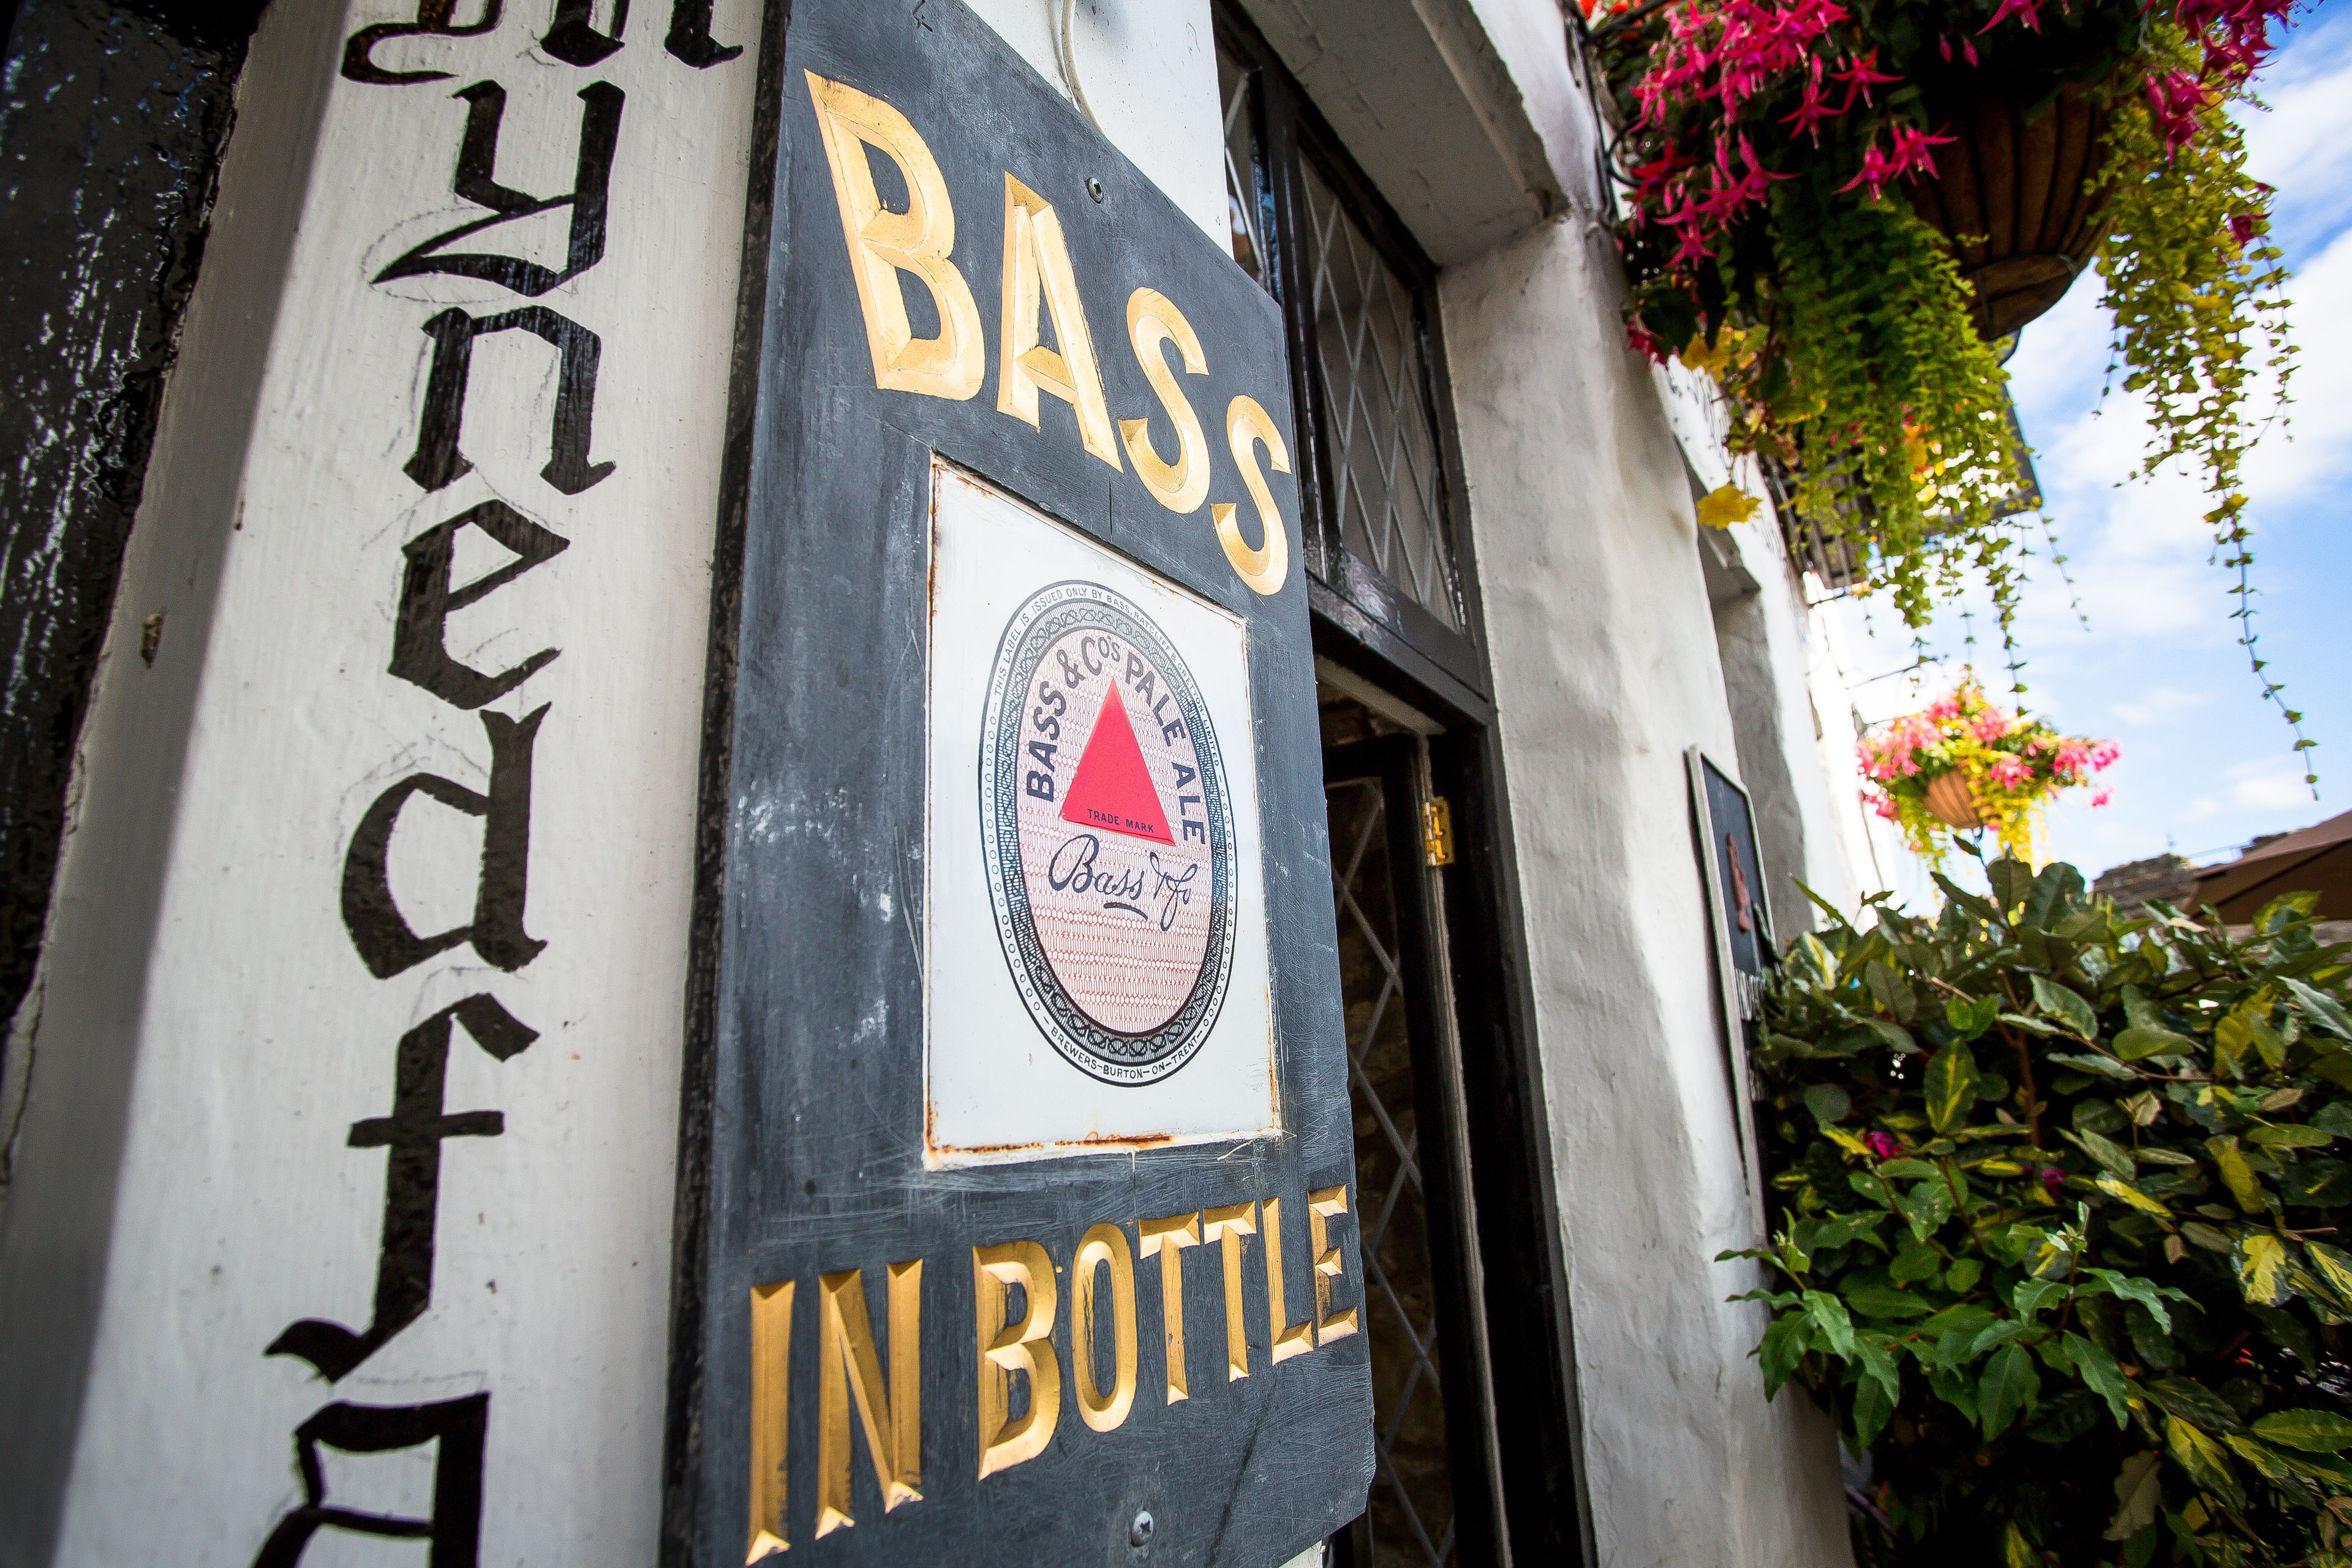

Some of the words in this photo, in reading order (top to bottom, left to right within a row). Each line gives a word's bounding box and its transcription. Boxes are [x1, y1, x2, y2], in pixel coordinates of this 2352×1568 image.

[804, 69, 1292, 595] BASS
[994, 666, 1007, 697] THIS
[1003, 628, 1022, 664] LABEL
[1020, 613, 1030, 626] IS
[1031, 589, 1063, 614] ISSUED
[1066, 587, 1088, 597] ONLY
[1091, 589, 1102, 599] BY
[1203, 719, 1219, 766] LIMITED
[1027, 680, 1066, 802] BASS
[1057, 649, 1087, 689] &
[1125, 650, 1186, 747] PALE
[1172, 761, 1206, 845] ALE
[1049, 834, 1144, 900] Bass
[1087, 809, 1120, 826] TRADE
[1126, 818, 1154, 833] MARK
[746, 1257, 924, 1567] IN
[973, 1184, 1359, 1480] BOTTLE
